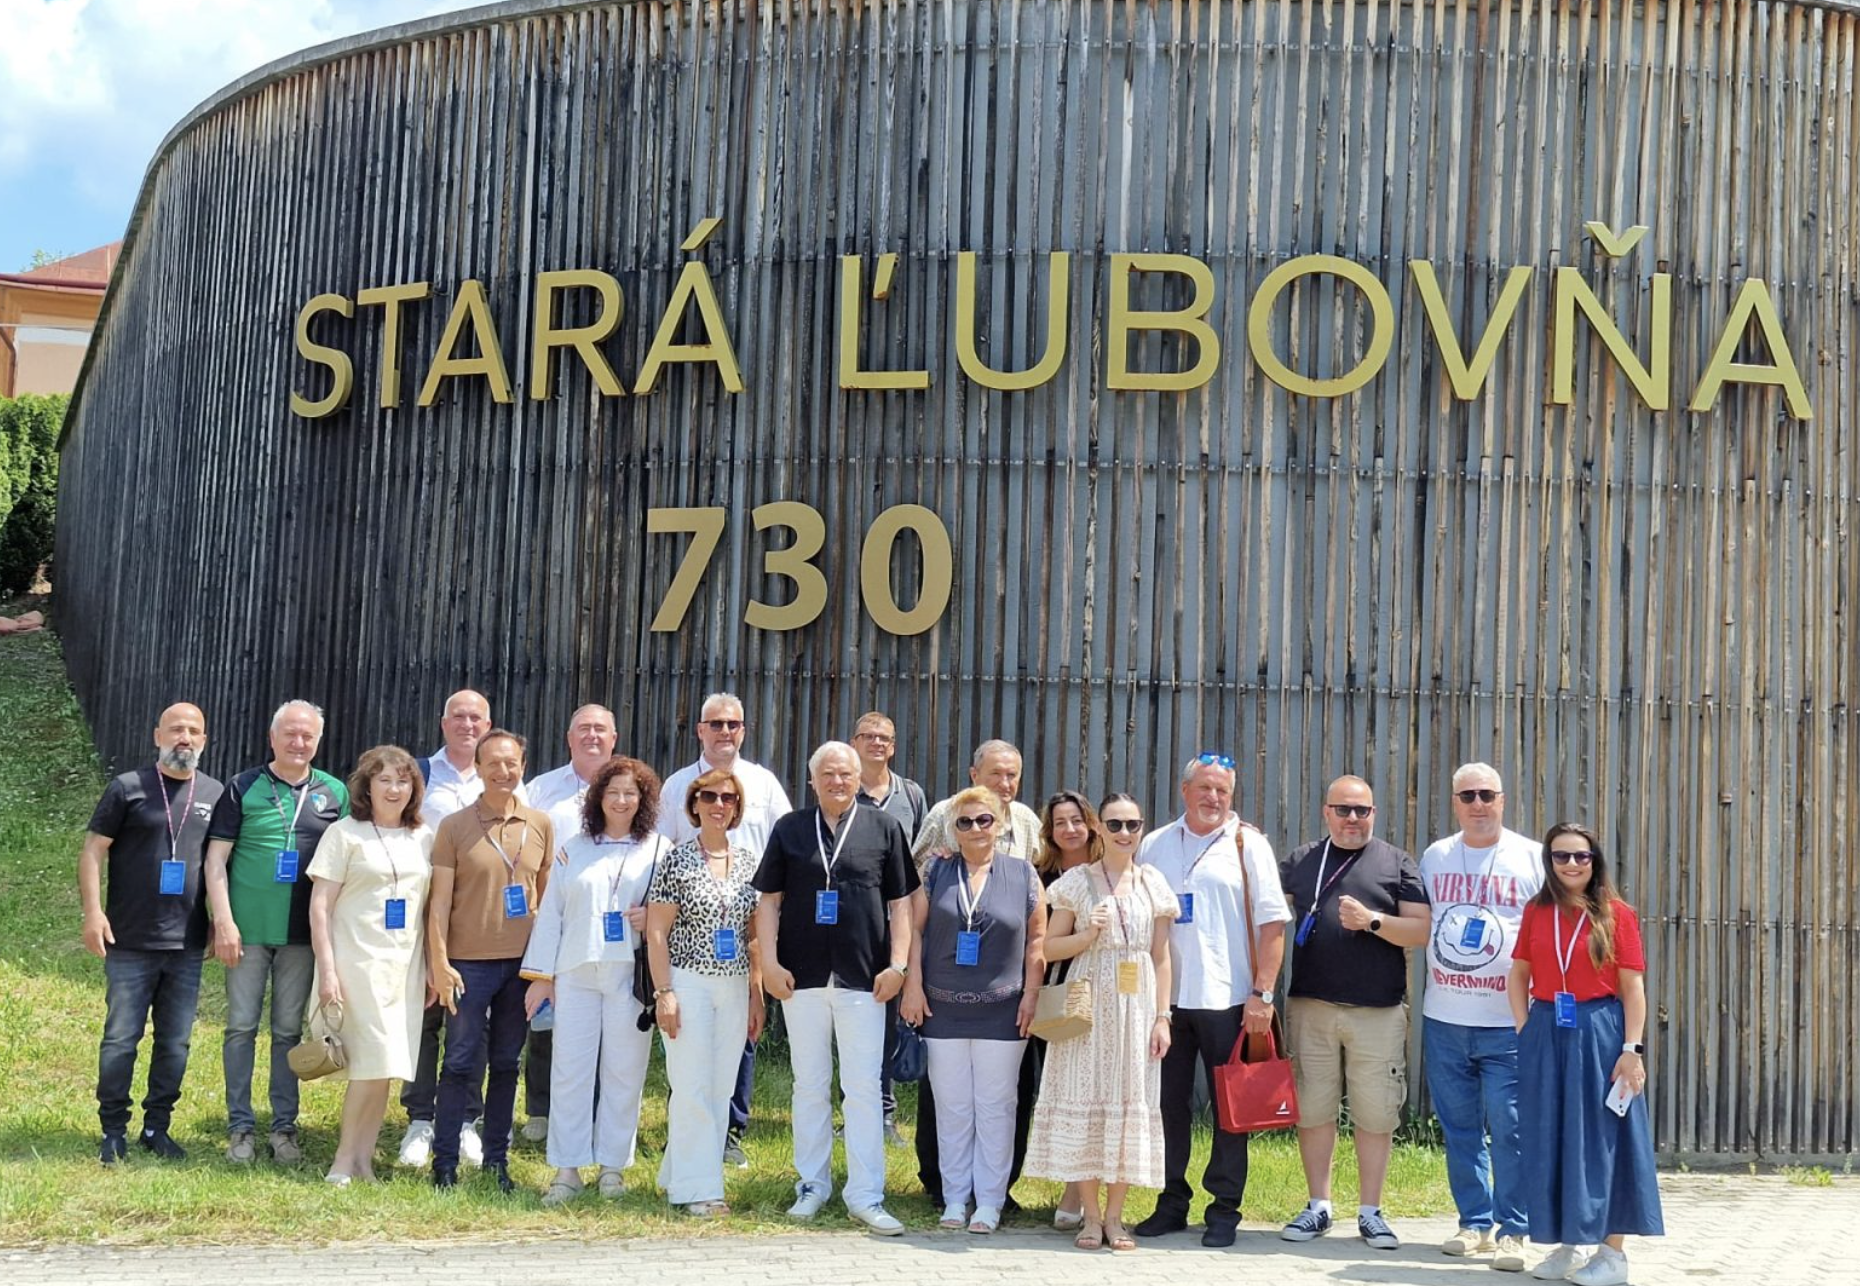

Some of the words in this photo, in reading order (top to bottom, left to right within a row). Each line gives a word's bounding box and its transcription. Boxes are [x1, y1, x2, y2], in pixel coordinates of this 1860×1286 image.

[290, 217, 746, 419] STARÁ
[839, 220, 1815, 420] ĽUBOVŇA
[646, 500, 954, 636] 730
[1432, 872, 1518, 908] NIRVANA
